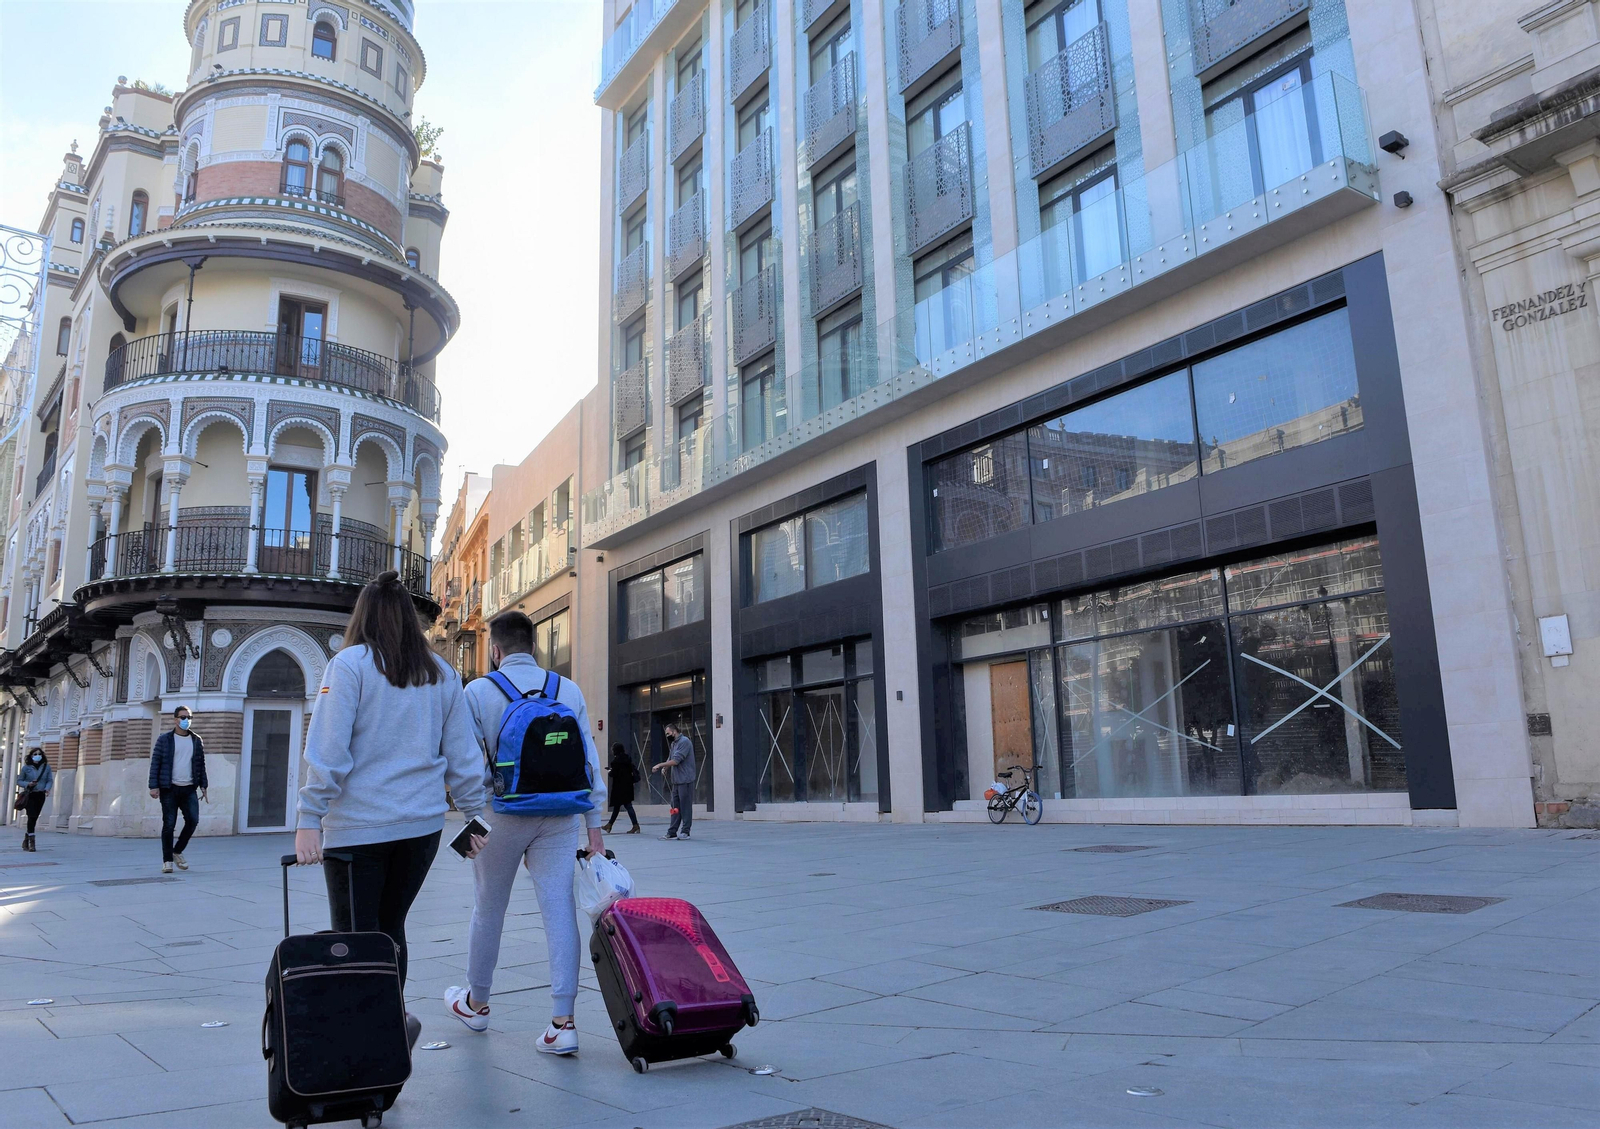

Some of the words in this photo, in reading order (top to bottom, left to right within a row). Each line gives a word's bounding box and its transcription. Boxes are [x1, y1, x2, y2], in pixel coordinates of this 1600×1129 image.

[1491, 283, 1575, 321] FERNANDEZ
[1576, 282, 1587, 293] Y
[1502, 294, 1588, 332] GONZALEZ
[544, 731, 569, 746] SP
